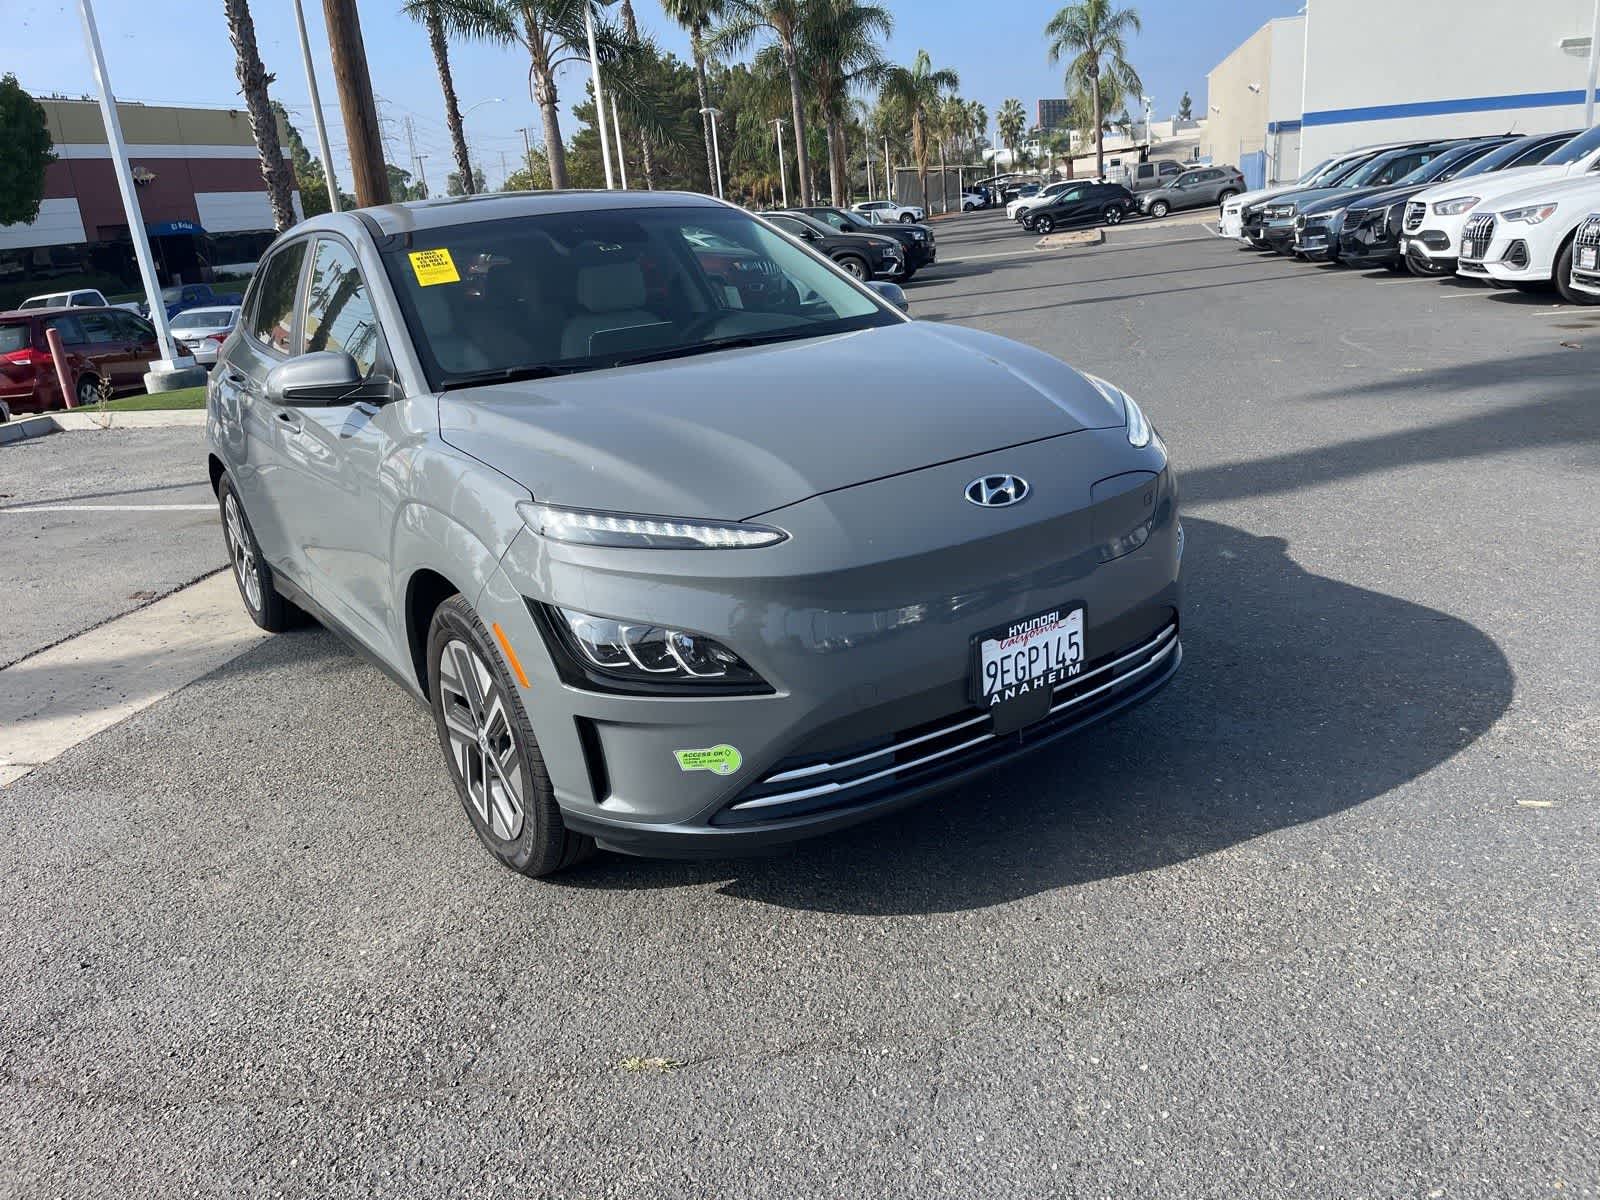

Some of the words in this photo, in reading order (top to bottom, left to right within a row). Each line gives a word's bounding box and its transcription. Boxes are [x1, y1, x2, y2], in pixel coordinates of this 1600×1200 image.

[1008, 611, 1059, 637] HYUNDAI
[986, 631, 1080, 694] 9EGP145
[990, 664, 1080, 706] ANAHEIM
